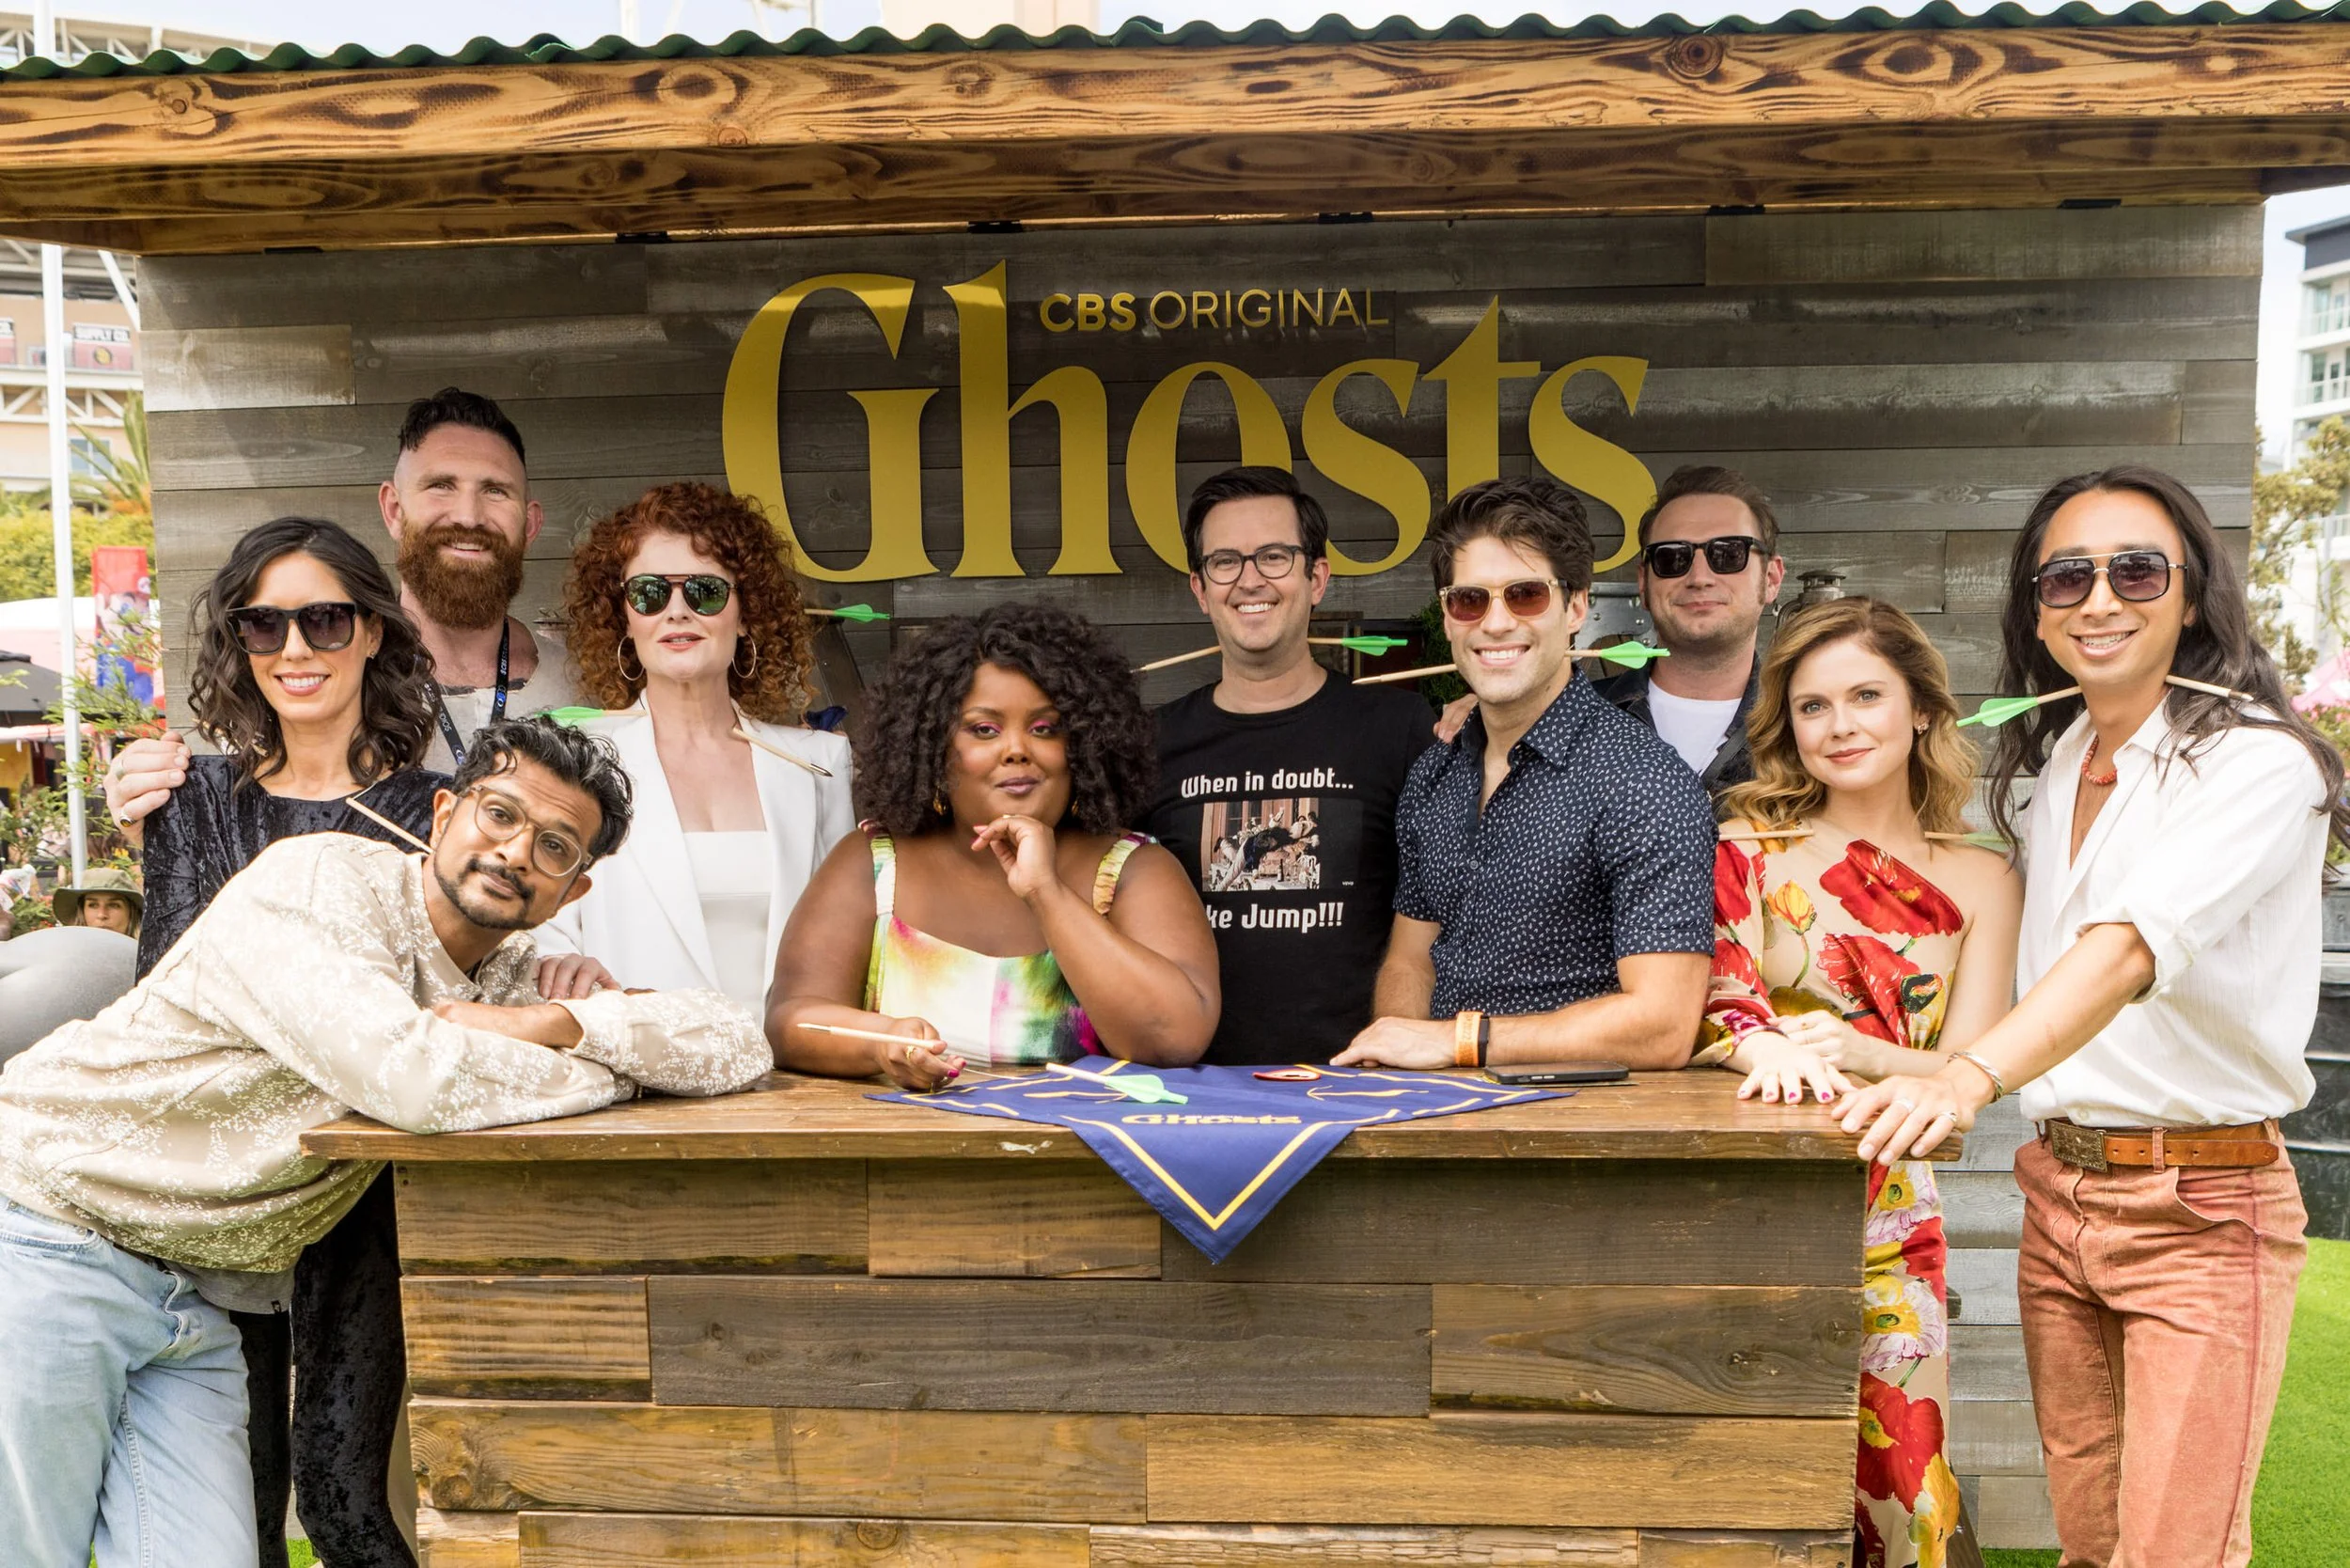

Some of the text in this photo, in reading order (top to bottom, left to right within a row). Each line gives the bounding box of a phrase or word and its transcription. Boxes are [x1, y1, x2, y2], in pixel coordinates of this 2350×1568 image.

[1040, 288, 1389, 332] CBS ORIGINAL
[721, 259, 1657, 583] Ghosts
[1181, 767, 1354, 798] When in doubt...
[1206, 902, 1344, 933] ke Jump!!!
